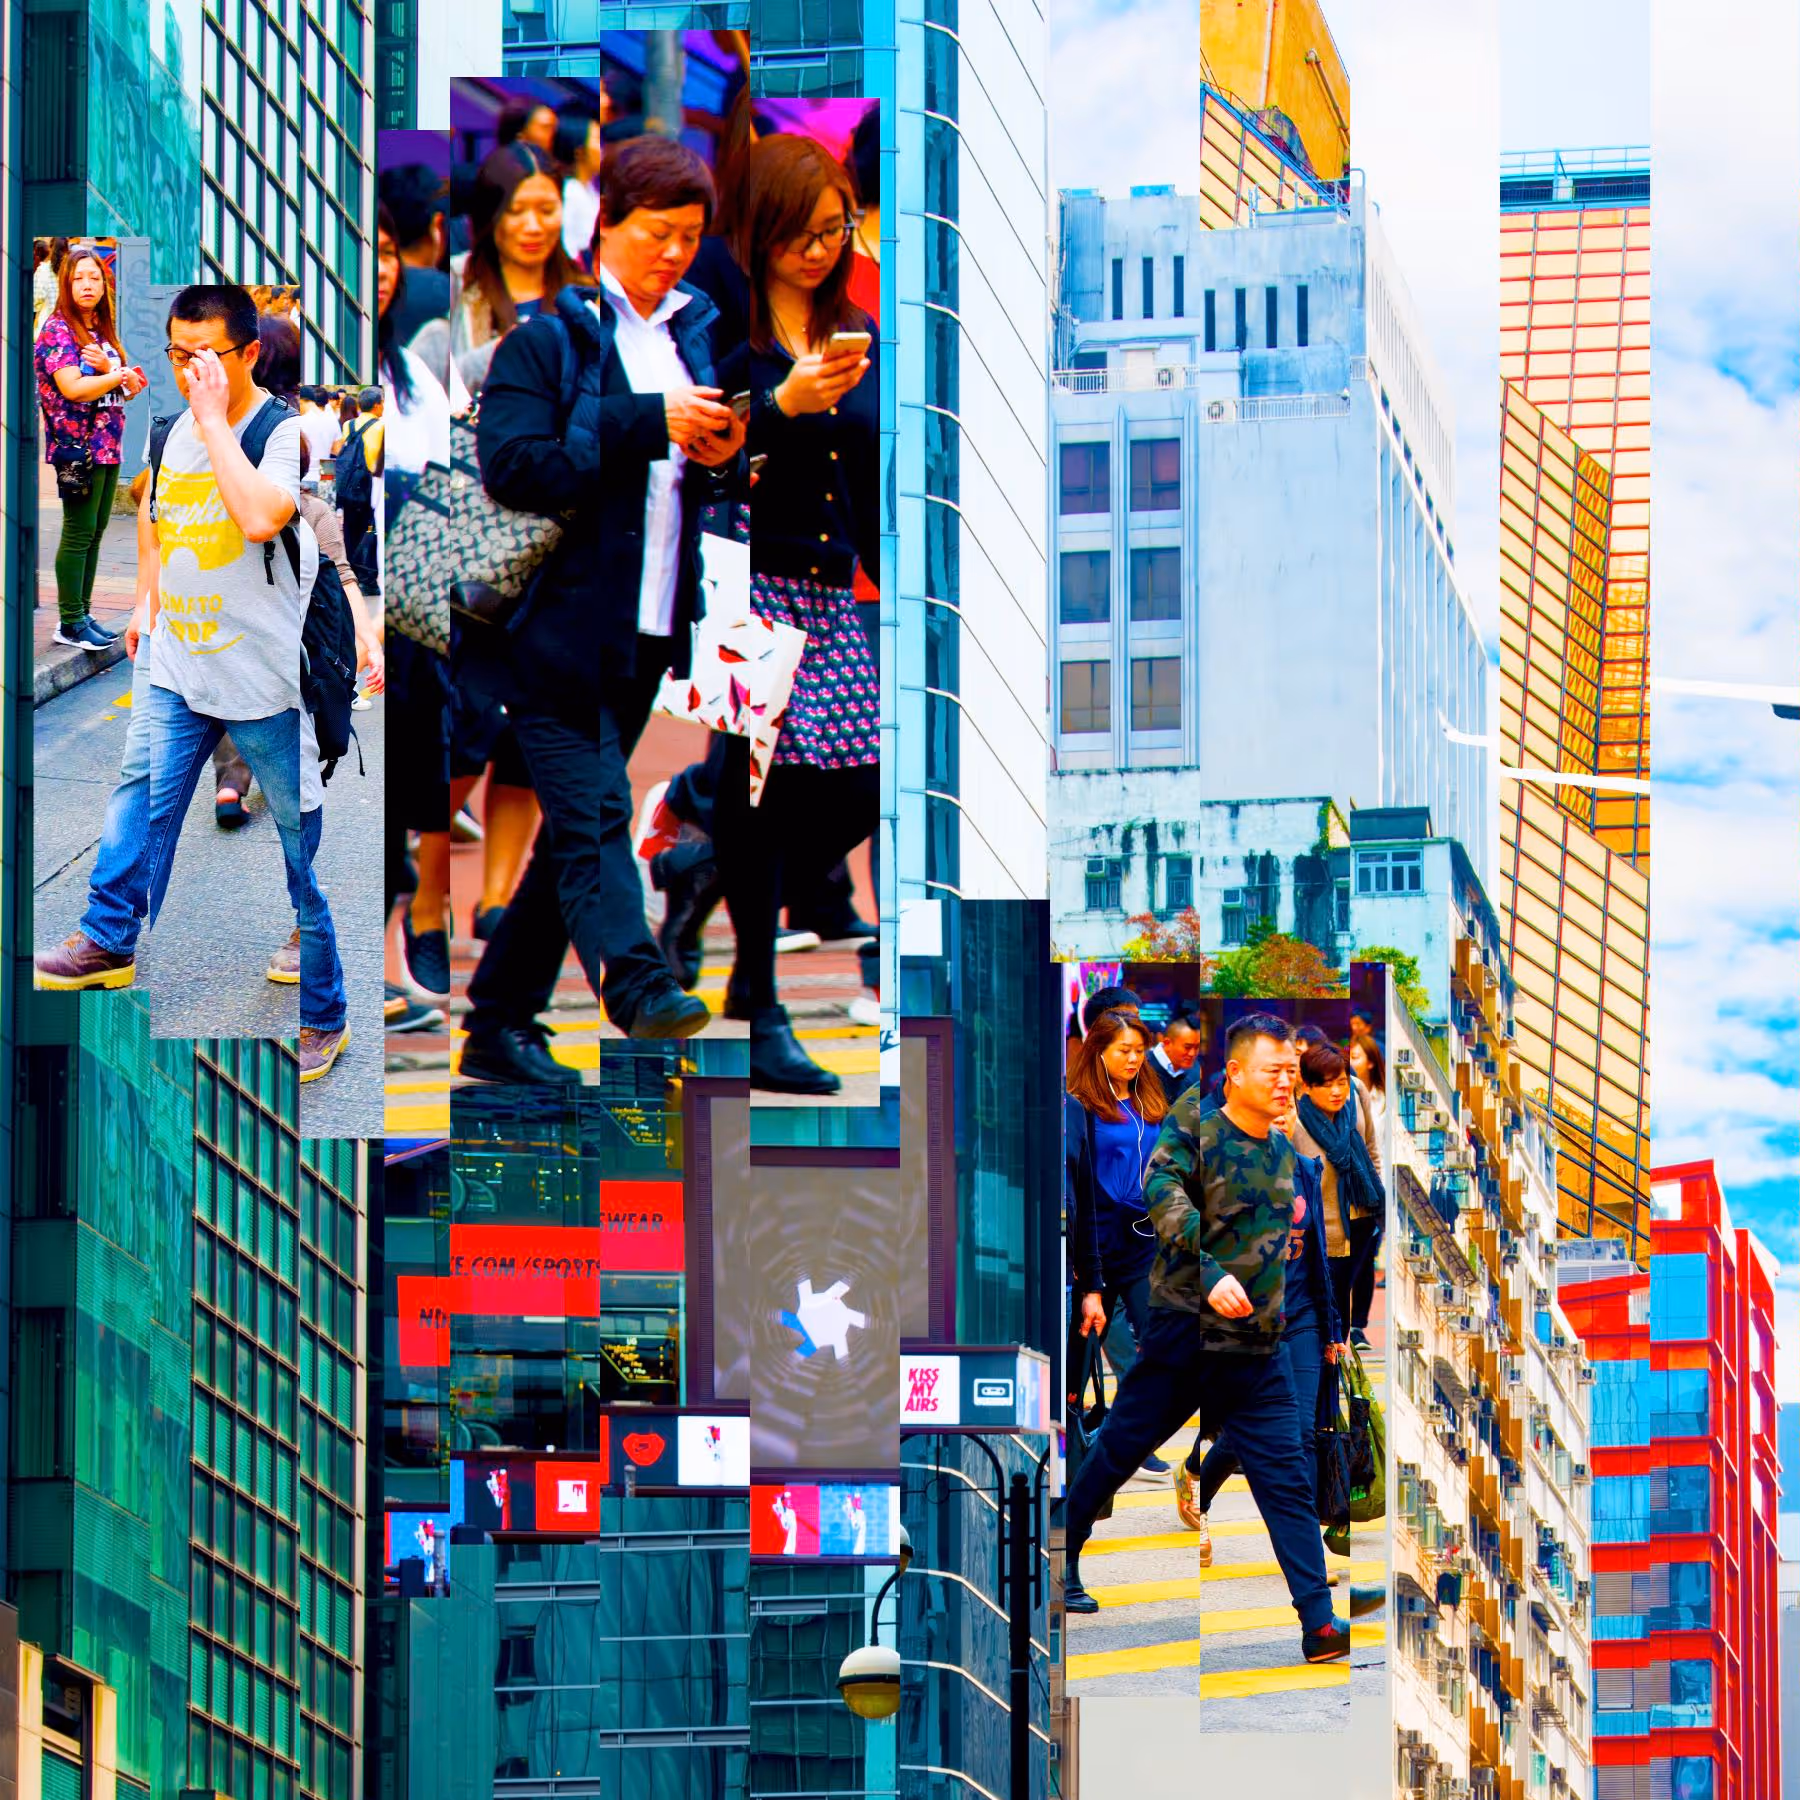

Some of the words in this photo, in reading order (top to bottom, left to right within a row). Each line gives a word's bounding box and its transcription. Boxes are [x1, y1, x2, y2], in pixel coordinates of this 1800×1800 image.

[909, 1368, 939, 1381] KISS
[910, 1380, 936, 1397] MY
[905, 1398, 938, 1411] AIRS
